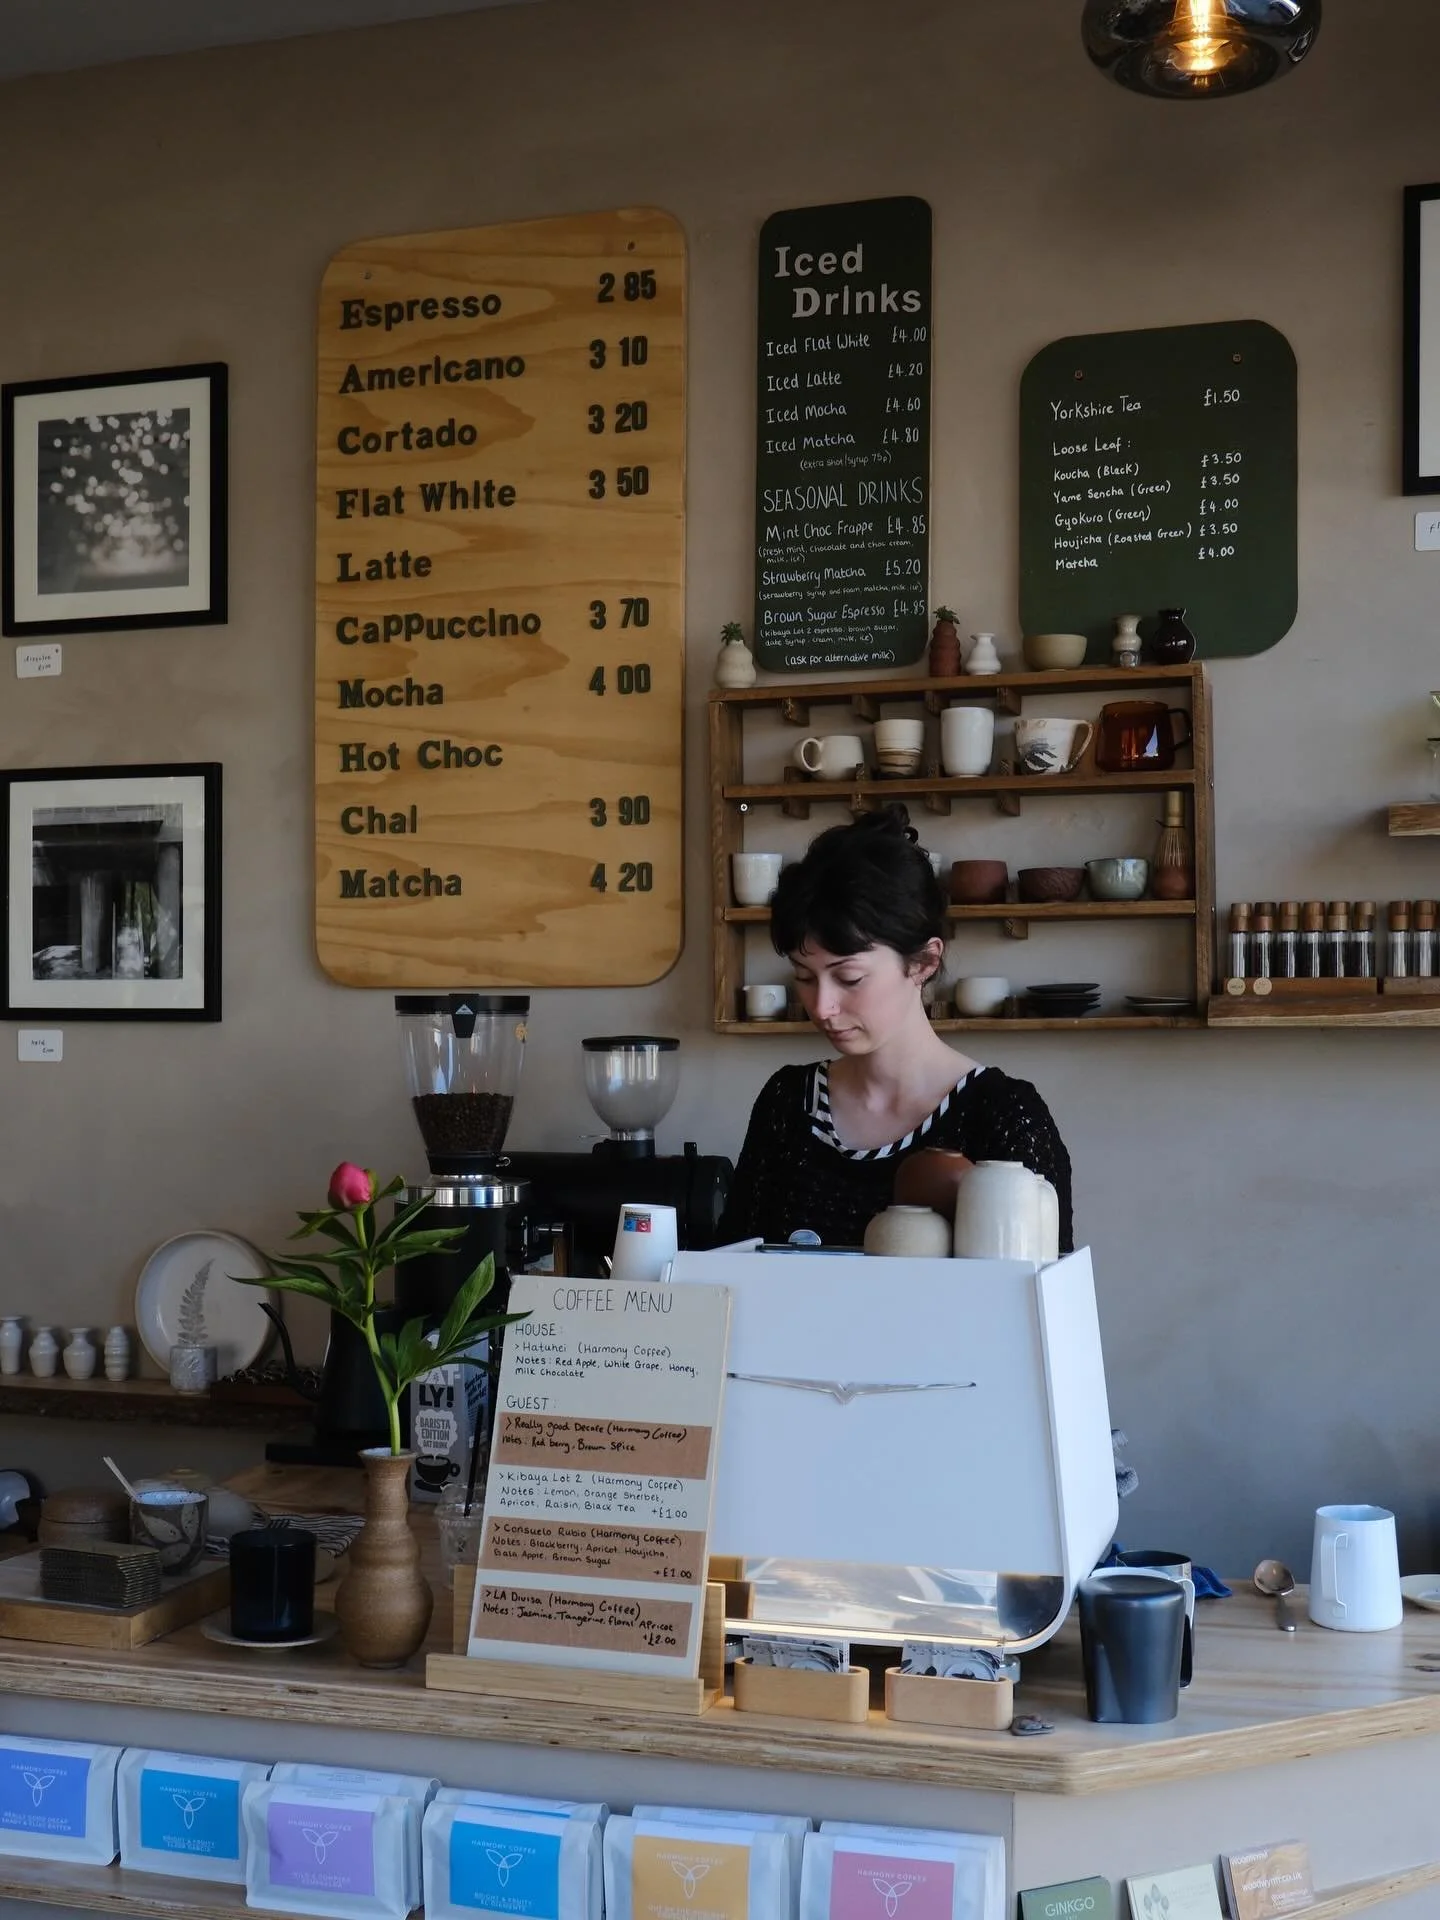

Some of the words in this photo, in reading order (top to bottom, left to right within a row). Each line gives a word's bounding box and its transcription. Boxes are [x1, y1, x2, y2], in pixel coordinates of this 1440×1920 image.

[774, 243, 863, 278] Iced
[339, 294, 501, 331] Espresso
[597, 273, 615, 302] 2
[623, 270, 657, 301] 85
[792, 284, 921, 318] Drinks
[767, 338, 797, 356] Iced
[805, 336, 831, 352] Flat
[837, 334, 870, 349] White
[892, 327, 926, 343] £4.00
[339, 355, 525, 394] Americano
[589, 339, 606, 369] 3
[619, 335, 648, 367] 10
[768, 374, 799, 391] Iced
[807, 371, 842, 387] Latte
[766, 406, 799, 424] Iced
[805, 404, 847, 420] Mocha
[1050, 401, 1114, 421] Yorkshire
[1120, 396, 1141, 412] Tea
[1203, 389, 1240, 406] £1.50
[337, 418, 477, 455] Cortado
[588, 404, 605, 434] 3
[615, 401, 647, 433] 20
[766, 438, 796, 454] Iced
[803, 433, 856, 448] Matcha
[1053, 442, 1088, 456] Loose
[1054, 469, 1089, 481] Koucha
[1201, 452, 1242, 467] £3.50
[335, 485, 404, 519] Flat
[420, 480, 516, 512] White
[589, 469, 605, 499] 3
[617, 465, 648, 497] 50
[763, 483, 848, 512] SEASONAL
[858, 476, 923, 506] DRINKS
[1054, 491, 1082, 503] Yame
[1088, 486, 1124, 499] Sencha
[1131, 480, 1171, 496] (Green)
[1200, 473, 1240, 489] £3.50
[766, 525, 799, 542] Mint
[804, 523, 832, 539] Choc
[838, 520, 873, 536] Frappe
[888, 515, 926, 534] £4.85
[1055, 512, 1103, 530] Gyokuro
[1108, 505, 1151, 523] (Green)
[1054, 535, 1102, 550] Houjicha
[1108, 532, 1152, 546] (Roasted
[1158, 522, 1192, 538] Green)
[1200, 523, 1238, 536] £3.50
[336, 550, 432, 582] Latte
[1056, 557, 1098, 570] Matcha
[1199, 546, 1235, 560] £4.00
[763, 571, 821, 588] Strawberry
[825, 568, 866, 580] Matcha
[886, 559, 920, 576] £5.20
[336, 608, 541, 645] Cappuccino
[589, 600, 606, 630] 3
[620, 598, 649, 629] 70
[764, 610, 802, 624] Brown
[807, 608, 837, 625] Sugar
[841, 604, 885, 620] Espresso
[785, 655, 807, 666] (ask
[810, 655, 823, 665] for
[825, 652, 868, 662] alternative
[338, 678, 444, 709] Mocha
[589, 666, 605, 696] 4
[617, 664, 650, 695] 00
[339, 742, 400, 772] Hot
[417, 739, 503, 769] Choc
[340, 805, 417, 835] Chai
[589, 798, 606, 826] 3
[618, 796, 650, 825] 90
[339, 868, 461, 898] Matcha
[590, 863, 607, 892] 4
[618, 862, 652, 892] 20
[553, 1288, 615, 1311] COFFEE
[624, 1291, 673, 1313] MENU
[556, 1358, 572, 1366] Red
[576, 1358, 600, 1368] Apple,
[605, 1360, 629, 1369] White
[578, 1344, 628, 1359] (Harmony
[634, 1345, 672, 1357] Coffee)
[541, 1369, 584, 1378] Chocolate
[420, 1384, 454, 1408] LY!
[420, 1417, 450, 1430] BARISTA
[422, 1428, 450, 1440] EDITION
[515, 1419, 542, 1434] Really
[548, 1423, 569, 1437] good
[607, 1422, 650, 1438] (Harmony
[532, 1438, 545, 1447] Red
[508, 1472, 548, 1485] Kibaya
[553, 1474, 570, 1482] Lot
[576, 1475, 582, 1483] 2
[592, 1475, 642, 1491] (Harmony
[648, 1479, 683, 1492] Coffee)
[585, 1490, 617, 1501] Orange
[585, 1501, 611, 1510] Black
[504, 1524, 552, 1536] Consuelo
[559, 1527, 586, 1537] Rubio
[591, 1529, 640, 1545] (Harmony
[644, 1533, 682, 1545] Coffee)
[552, 1554, 582, 1562] Brown
[586, 1556, 610, 1568] Sugar
[548, 1593, 594, 1614] (Harmony
[599, 1600, 641, 1621] Coffee)
[1045, 1896, 1094, 1916] GINKGO
